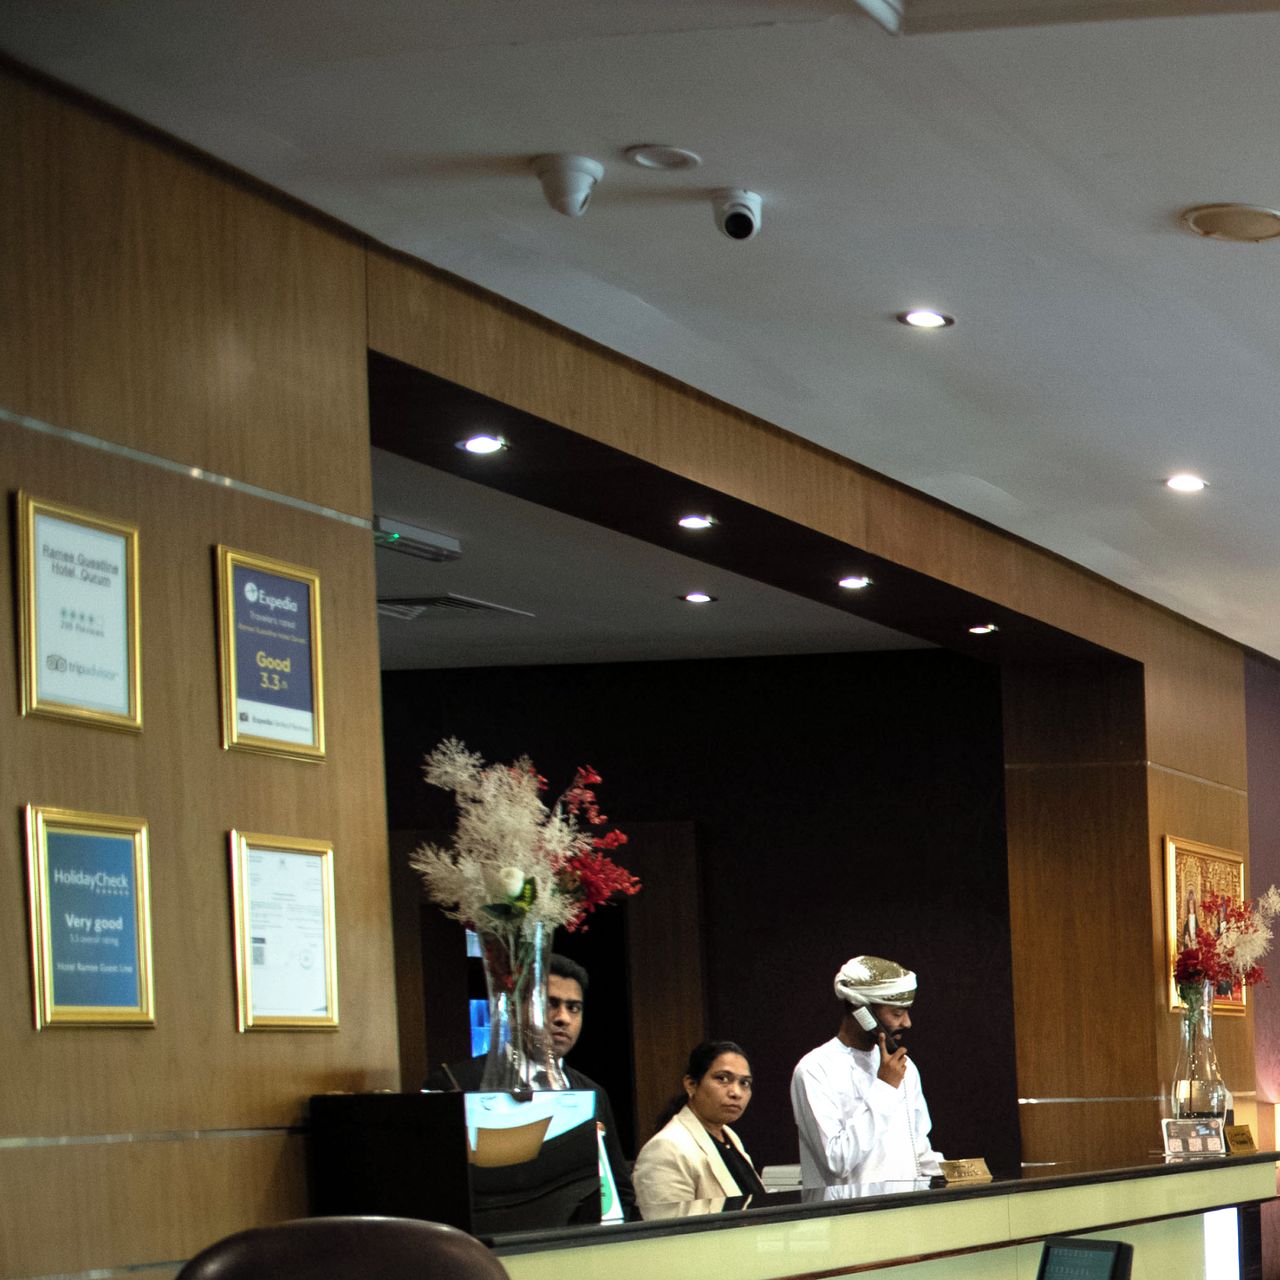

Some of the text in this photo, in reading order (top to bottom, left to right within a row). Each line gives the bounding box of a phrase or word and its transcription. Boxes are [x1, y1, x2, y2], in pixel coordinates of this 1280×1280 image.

[259, 589, 298, 613] Expedia
[256, 651, 292, 673] Good
[53, 868, 129, 890] HolidayCheck
[64, 913, 123, 933] Very good
